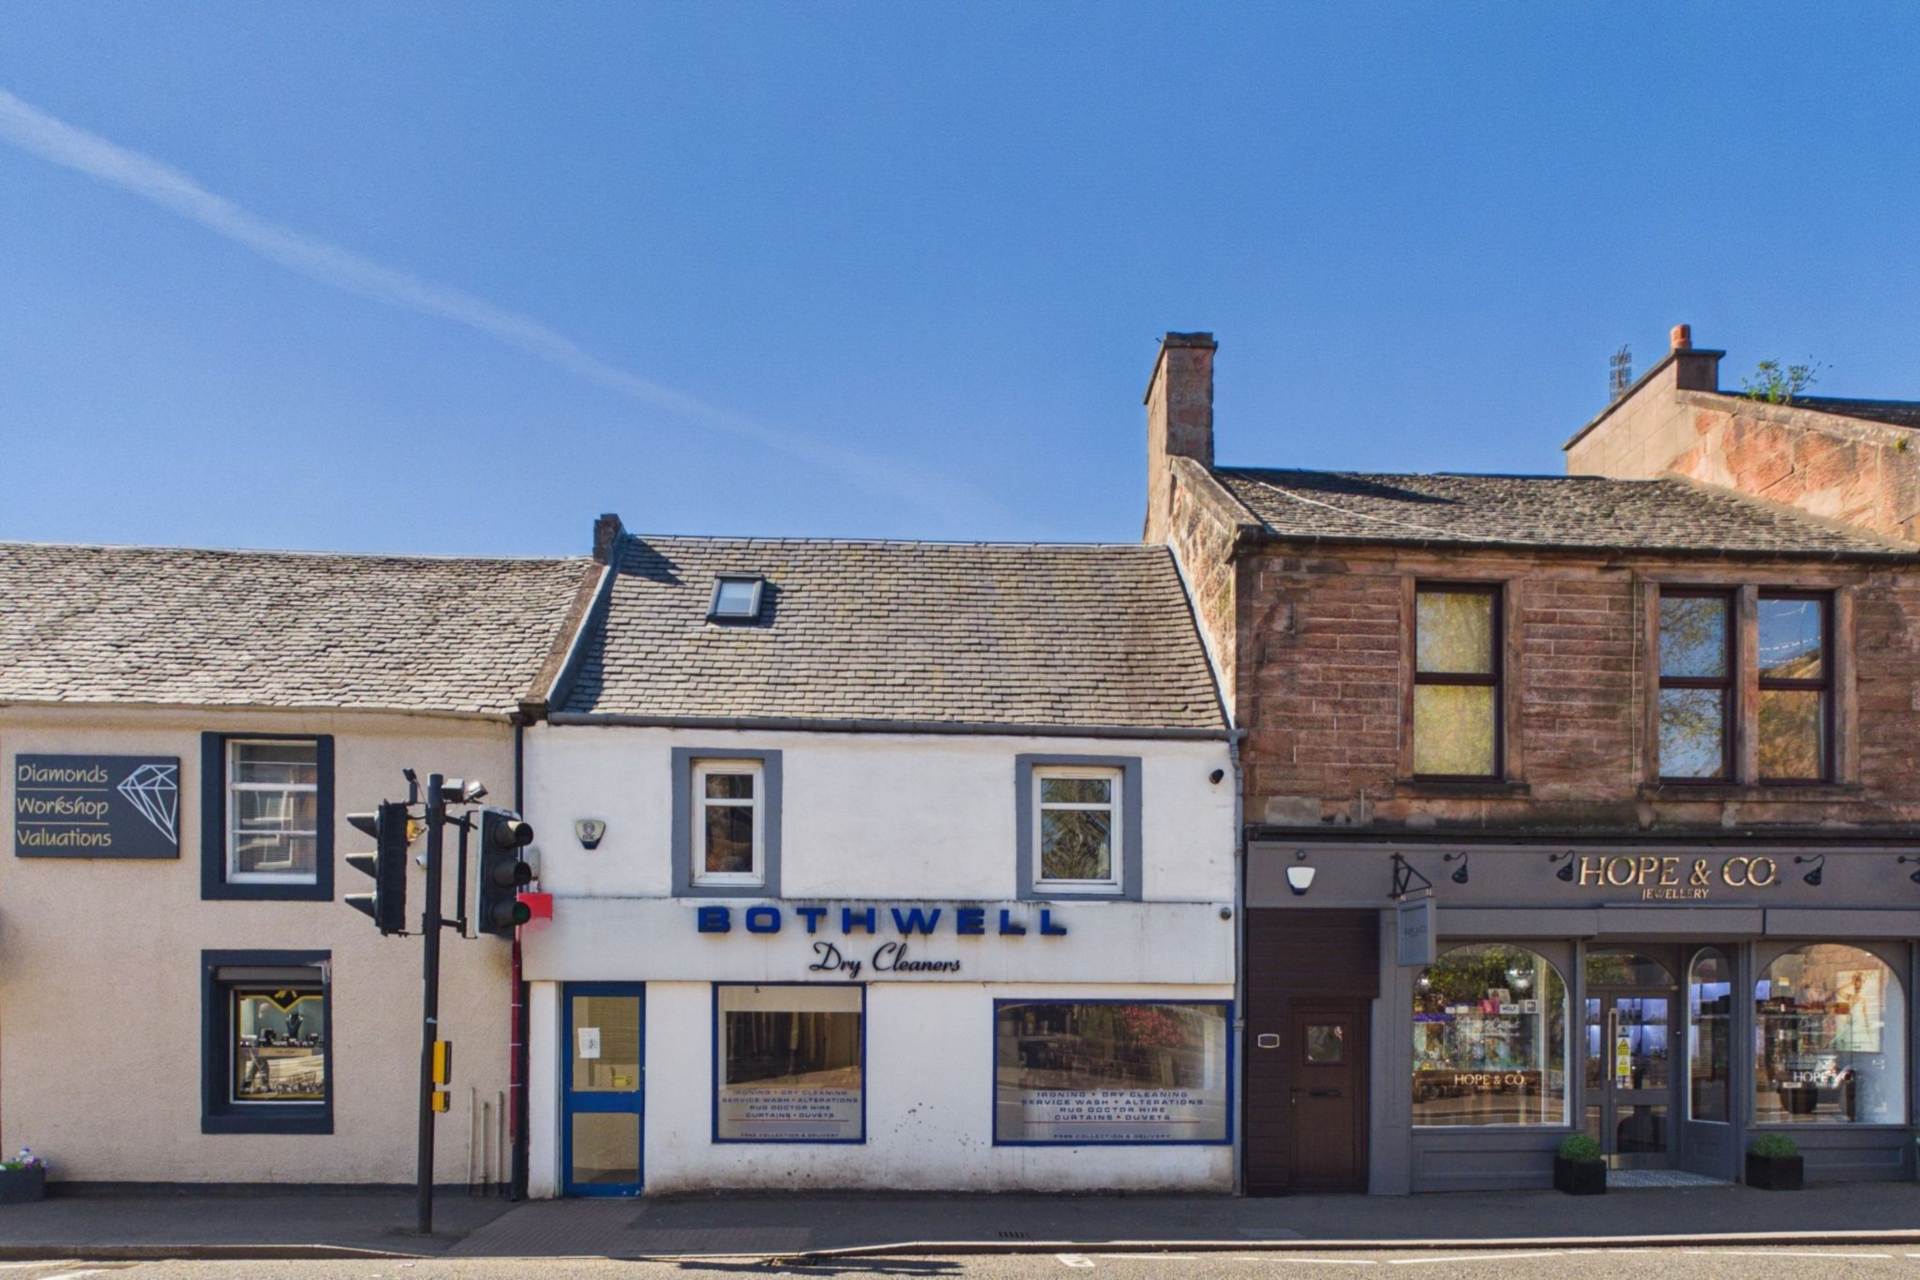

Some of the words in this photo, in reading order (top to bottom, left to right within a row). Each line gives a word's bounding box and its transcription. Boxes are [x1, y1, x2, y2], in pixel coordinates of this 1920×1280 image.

[18, 763, 109, 783] Diamonds
[17, 796, 109, 820] Workshop
[17, 828, 112, 847] Valuations
[1578, 856, 1680, 886] HOPE
[1690, 859, 1712, 886] &
[697, 905, 1067, 936] BOTHWELL
[809, 942, 862, 978] Dry
[872, 942, 960, 973] Cleaners
[1454, 1074, 1491, 1085] HOPE
